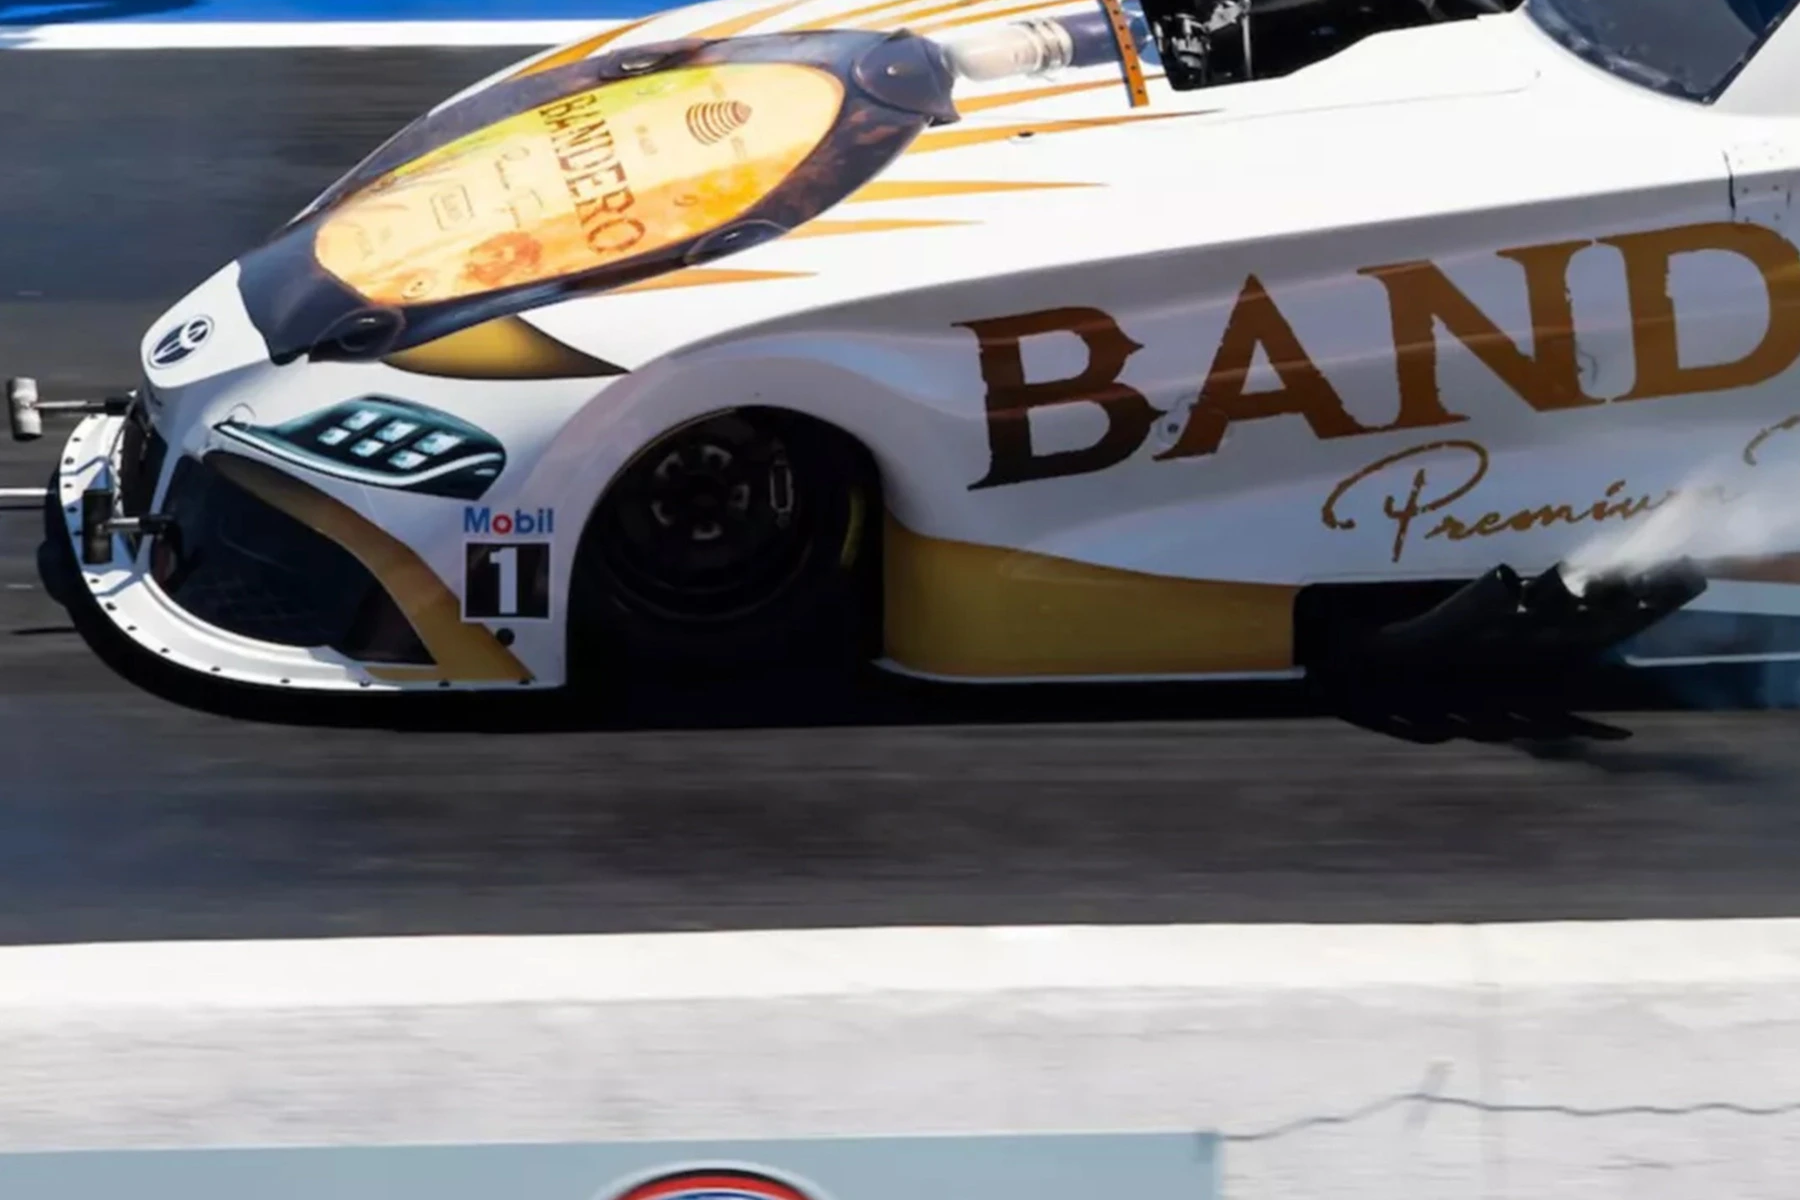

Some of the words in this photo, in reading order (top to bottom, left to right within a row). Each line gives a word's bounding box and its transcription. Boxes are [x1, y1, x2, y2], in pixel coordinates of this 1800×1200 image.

[538, 93, 646, 254] BANDERO
[462, 506, 555, 535] Mobil
[1321, 439, 1743, 564] Premiu
[488, 547, 519, 615] 1
